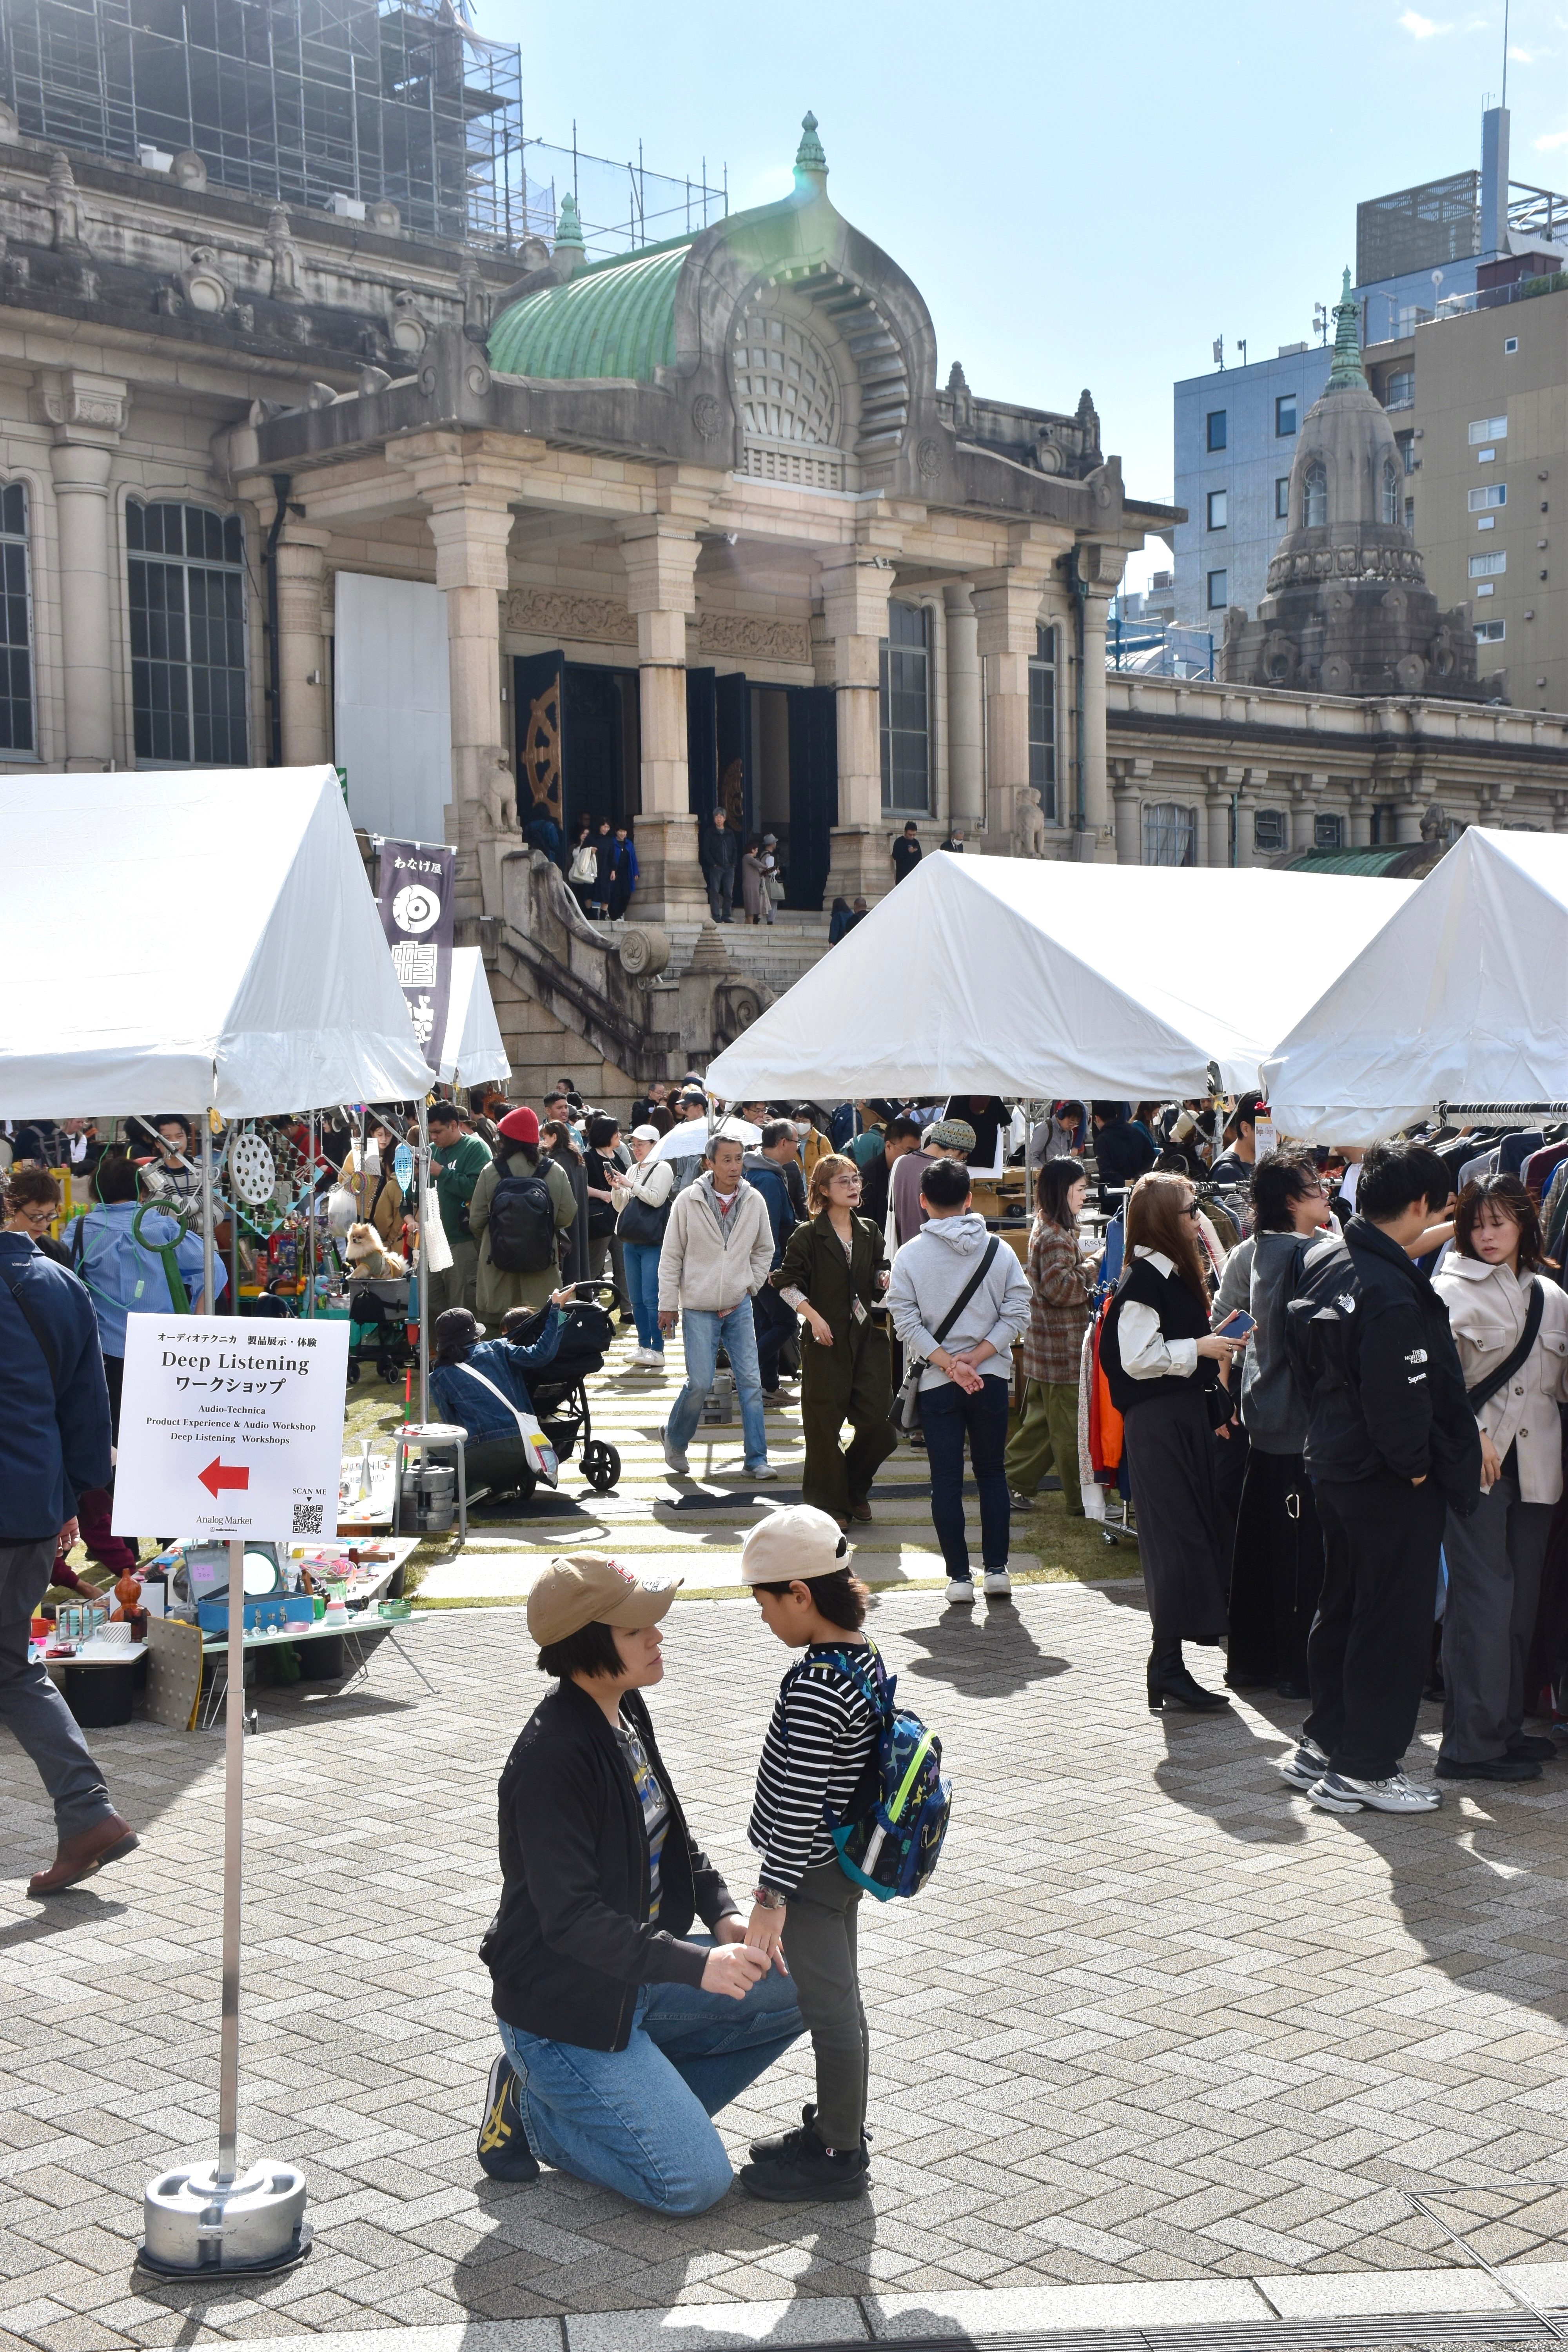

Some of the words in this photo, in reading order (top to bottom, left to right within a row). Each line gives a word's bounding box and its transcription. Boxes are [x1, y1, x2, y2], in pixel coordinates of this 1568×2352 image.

[394, 856, 442, 875] わなげ屋
[158, 1333, 237, 1344] オーディオテクニカ
[247, 1335, 317, 1347] 製品展示・体験
[161, 1352, 210, 1372] Deep
[218, 1354, 309, 1375] Listening
[176, 1377, 286, 1394] ワークショップ
[1408, 1373, 1426, 1384] Supreme
[198, 1405, 265, 1414] Audio-Technica
[146, 1417, 180, 1425] Product
[183, 1419, 230, 1428] Experience
[272, 1422, 316, 1432] Workshop
[171, 1433, 192, 1442] Deep
[195, 1434, 236, 1444] Listening
[242, 1435, 290, 1445] Workshops
[196, 1515, 223, 1525] Analog
[225, 1516, 252, 1524] Market
